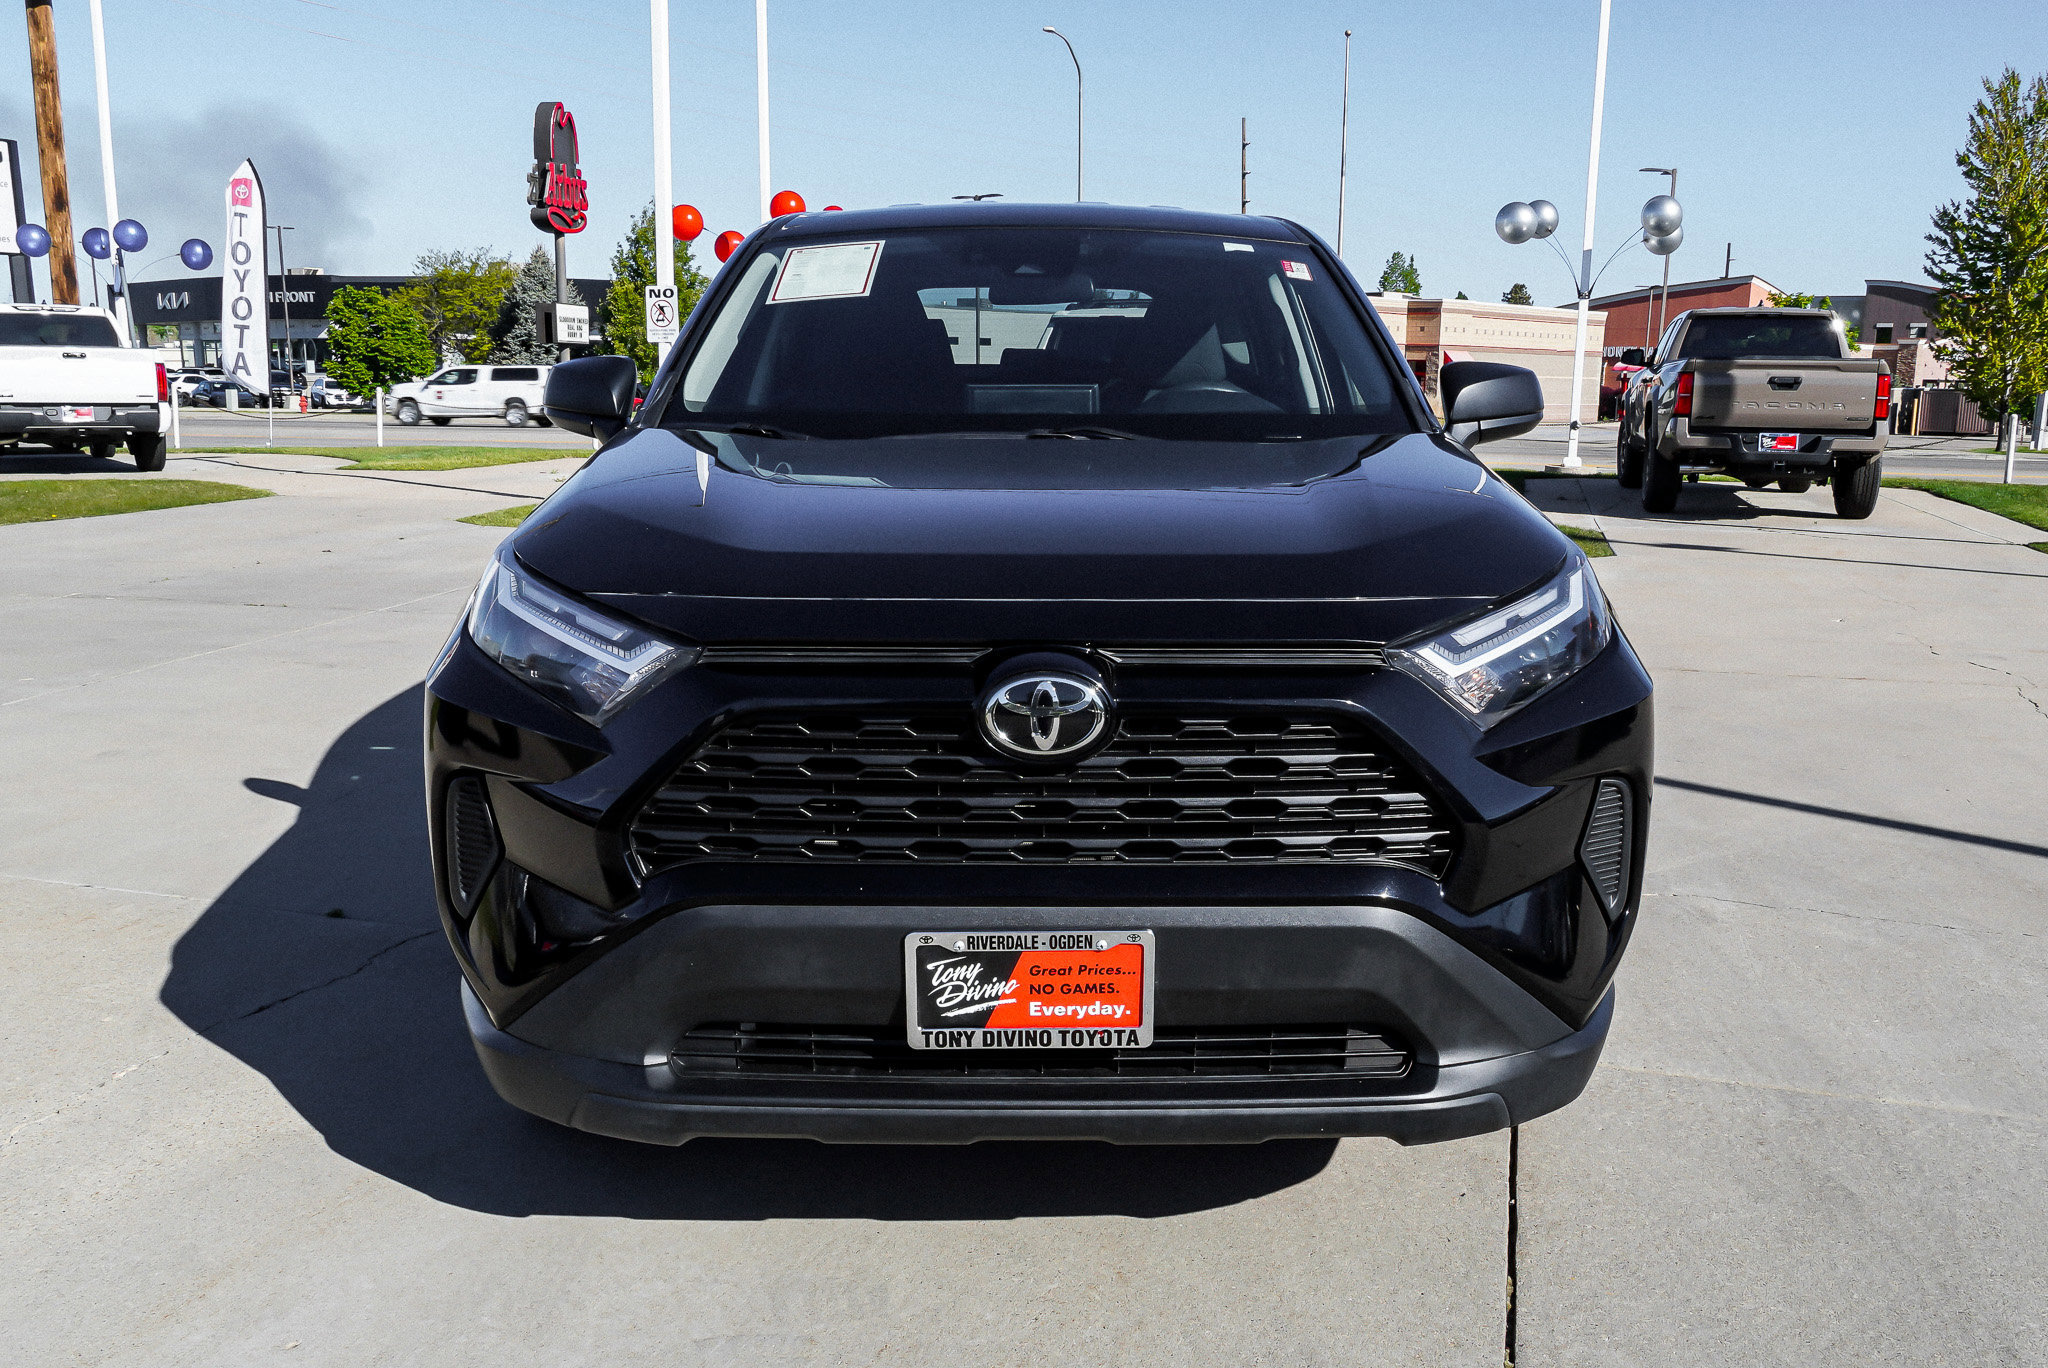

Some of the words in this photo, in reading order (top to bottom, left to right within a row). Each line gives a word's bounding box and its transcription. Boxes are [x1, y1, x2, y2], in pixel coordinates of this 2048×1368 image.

[545, 162, 588, 211] Arby's
[156, 291, 190, 310] KIA
[231, 211, 253, 377] TOYOTA
[649, 288, 675, 299] NO
[1732, 401, 1846, 410] TACOMA
[966, 935, 1039, 950] RIVERDALE
[1049, 934, 1093, 949] OGDEN
[926, 956, 983, 986] Tony
[1029, 964, 1072, 976] Great
[1078, 963, 1136, 976] Prices...
[928, 977, 1020, 1008] Divino
[1029, 983, 1054, 995] NO
[1060, 983, 1120, 995] GAMES.
[1029, 1002, 1131, 1019] Everyday.
[921, 1031, 975, 1048] TONY
[983, 1030, 1052, 1047] DIVINO
[1058, 1030, 1140, 1046] TOYOTA
